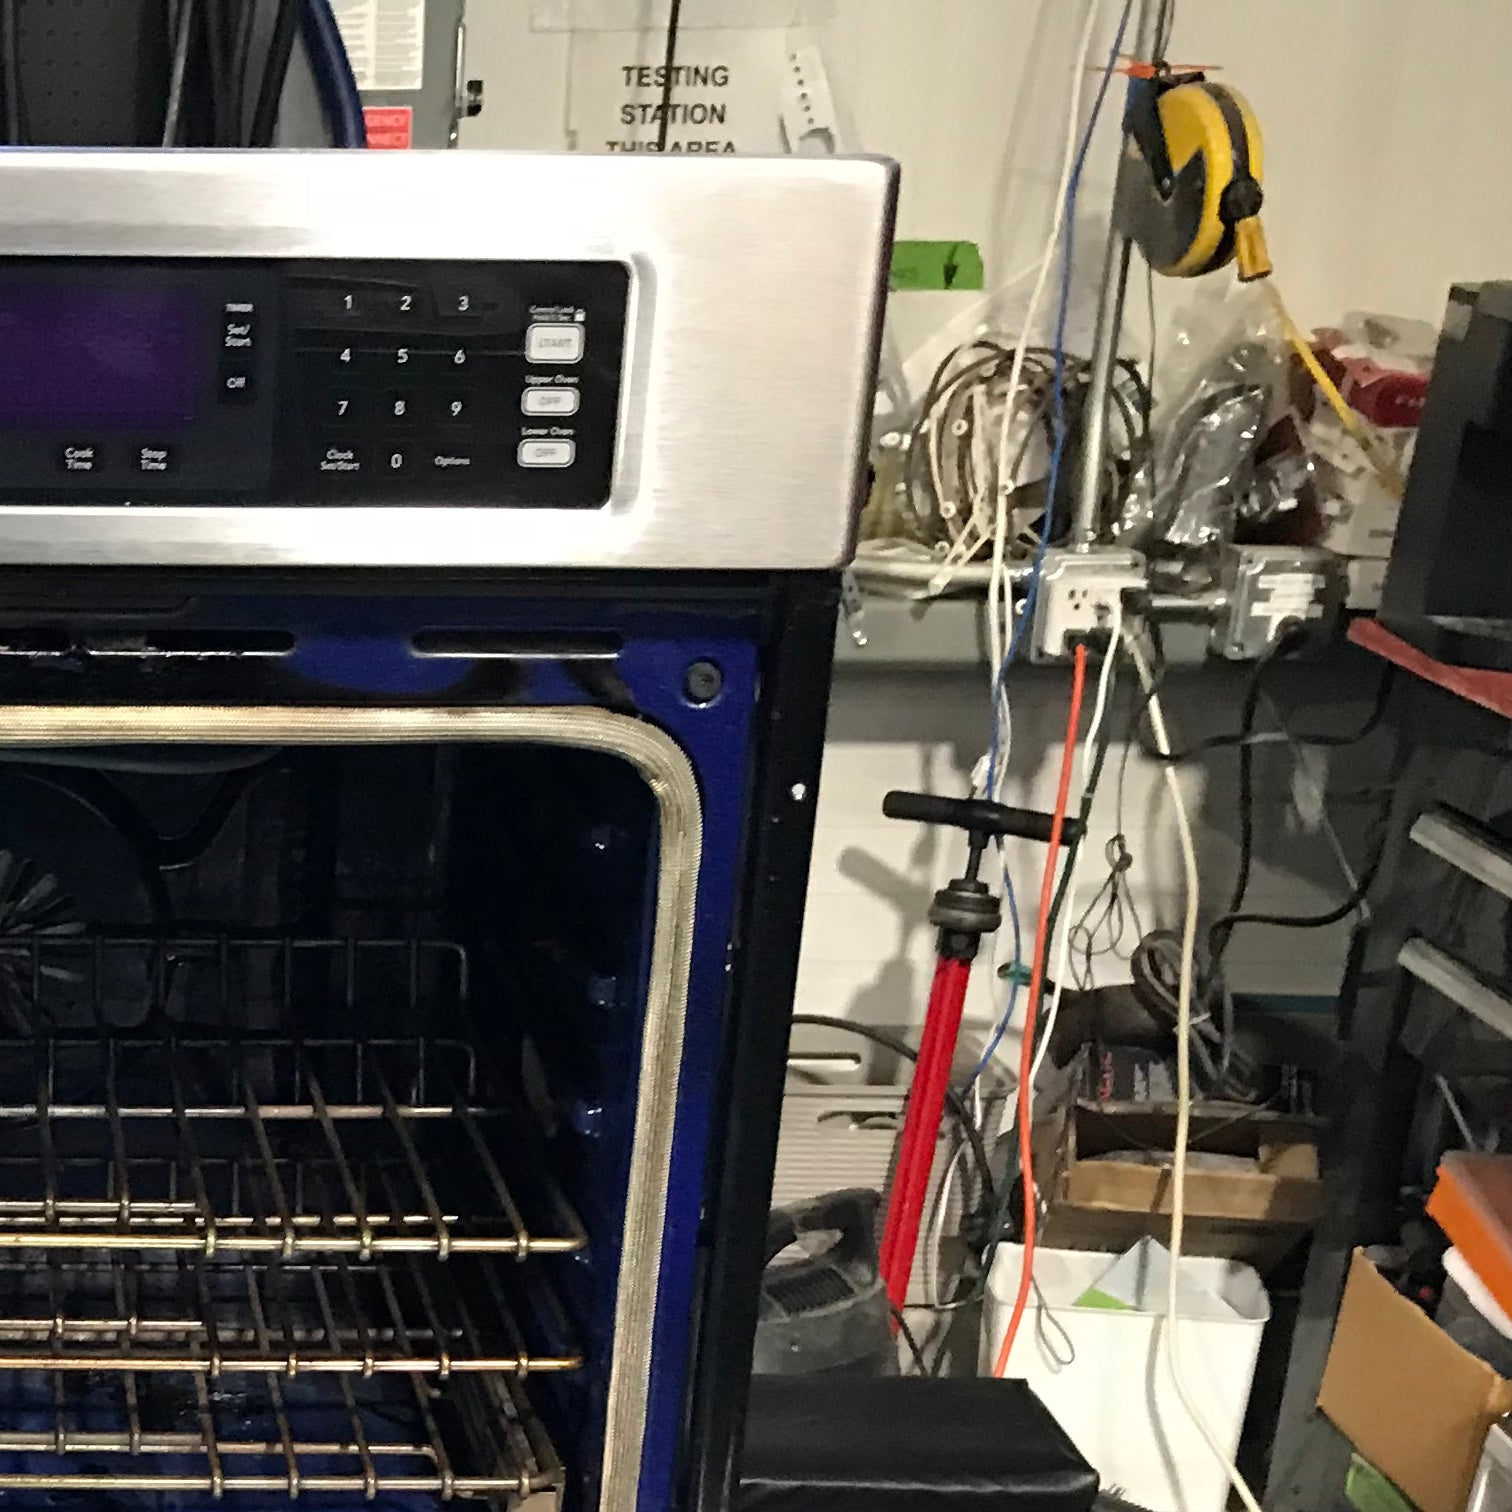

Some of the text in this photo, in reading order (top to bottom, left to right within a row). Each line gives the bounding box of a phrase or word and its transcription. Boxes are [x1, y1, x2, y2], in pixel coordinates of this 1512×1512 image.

[622, 65, 729, 87] TESTING
[620, 103, 726, 125] STATION
[344, 295, 353, 309] 1
[400, 295, 412, 310] 2
[458, 295, 469, 310] 3
[340, 348, 352, 363] 4
[397, 348, 409, 363] 5
[454, 349, 466, 364] 6
[227, 377, 246, 388] Off
[337, 401, 349, 415] 7
[394, 400, 406, 416] 8
[451, 401, 463, 416] 9
[65, 447, 94, 459] Cook
[390, 453, 403, 469] 0
